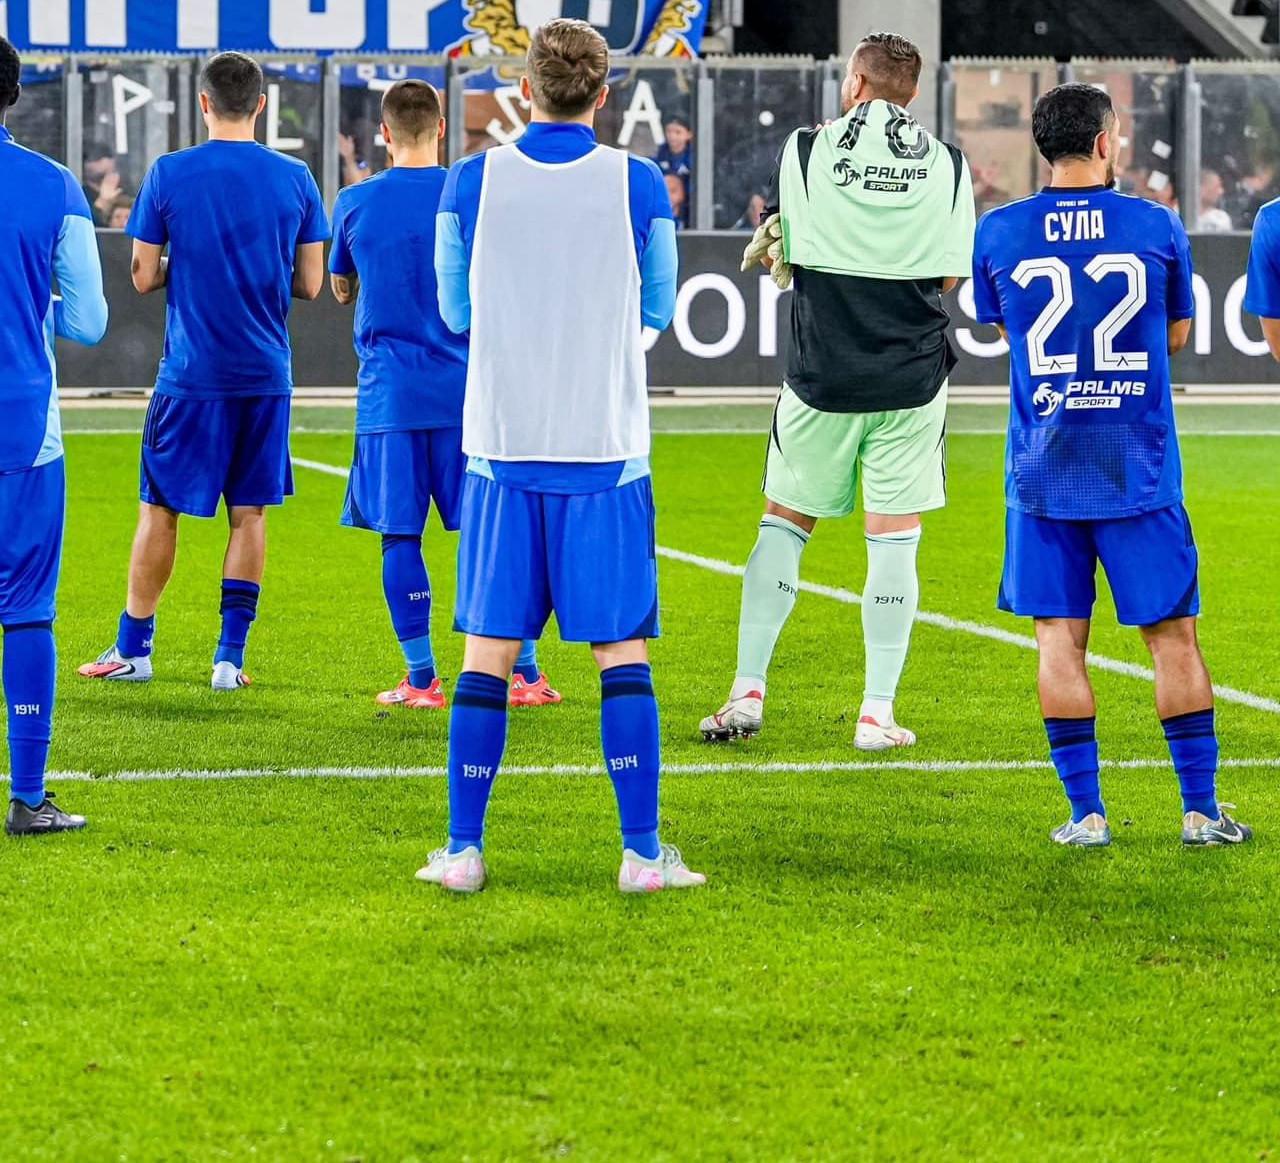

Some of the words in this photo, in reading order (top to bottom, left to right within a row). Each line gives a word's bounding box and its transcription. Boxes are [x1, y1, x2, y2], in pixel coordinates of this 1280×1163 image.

[863, 165, 928, 180] PALMS
[868, 182, 904, 191] SPORT
[1044, 209, 1105, 242] СУЛА
[1010, 253, 1148, 376] 22
[1065, 381, 1146, 396] PALMS
[1072, 398, 1114, 407] SPORT
[874, 596, 905, 604] 1914
[14, 704, 39, 715] 1914
[609, 754, 638, 771] 1914
[462, 764, 492, 779] 1914
